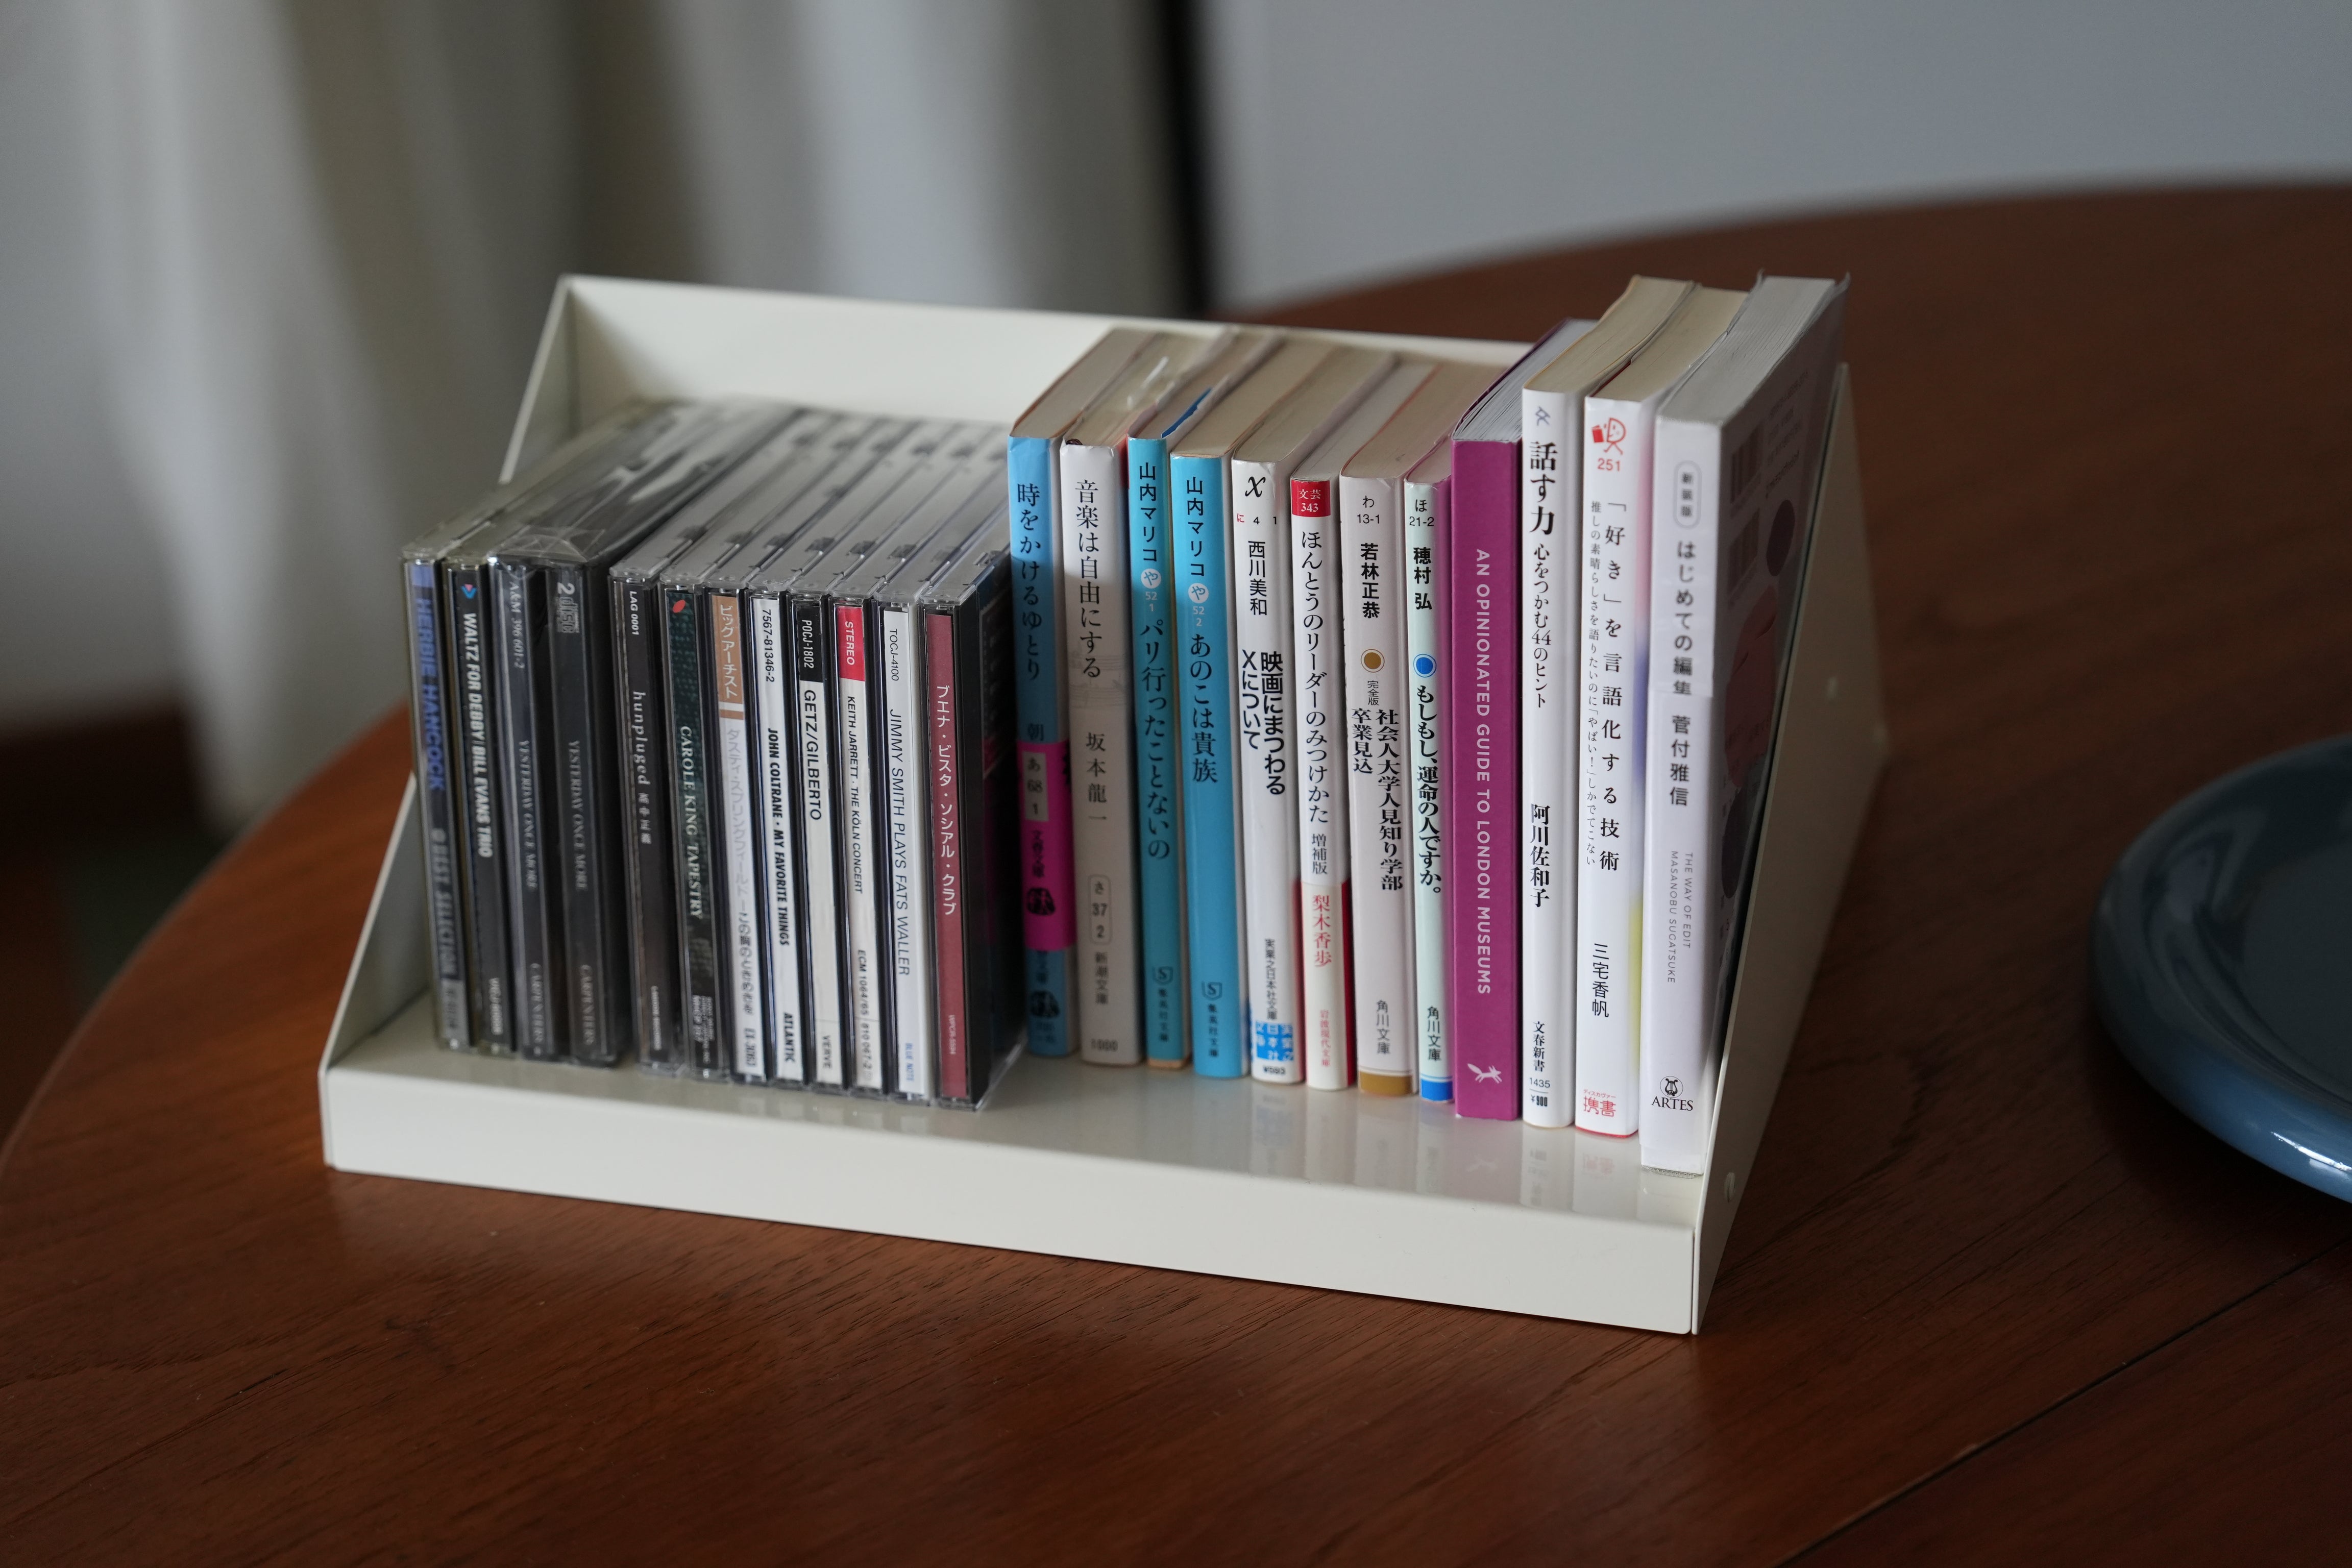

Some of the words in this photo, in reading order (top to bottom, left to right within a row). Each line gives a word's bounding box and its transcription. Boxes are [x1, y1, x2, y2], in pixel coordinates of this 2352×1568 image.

[1529, 441, 1558, 535] 話す力
[1597, 458, 1622, 472] 251
[1140, 462, 1158, 562] 山内マリコ
[1298, 489, 1321, 500] 文芸
[1301, 502, 1319, 512] 343
[1362, 496, 1374, 508] わ
[1415, 499, 1427, 511] ほ
[1187, 477, 1205, 577] 山内マリコ
[1237, 513, 1244, 523] に
[1357, 513, 1380, 525] 13-1
[1409, 517, 1435, 527] 21-2
[1017, 483, 1042, 680] 時をかけるゆとり
[1075, 479, 1102, 678] 音楽は自由にする
[1142, 570, 1160, 586] や
[1248, 541, 1267, 616] 西川美和
[1360, 543, 1379, 619] 若林正恭
[1476, 549, 1490, 576] AN
[557, 582, 575, 595] 2
[629, 591, 639, 612] LAG
[1145, 592, 1158, 601] 52
[1149, 603, 1154, 611] 1
[1191, 584, 1207, 601] や
[1193, 606, 1205, 615] 52
[416, 599, 437, 677] HERBIE
[463, 613, 480, 662] WALTZ
[512, 617, 523, 636] 396
[631, 615, 640, 635] 0001
[1196, 618, 1202, 627] 2
[1531, 544, 1552, 708] 心をつかむ44のヒント
[1673, 541, 1696, 696] はじめての編集
[513, 639, 526, 669] 601-2
[763, 608, 774, 682] 7567-81346-2
[801, 620, 814, 669] POCJ-1802
[845, 621, 855, 665] STEREO
[889, 628, 899, 681] TOCJ-4100
[1477, 584, 1490, 716] OPINIONATED
[467, 665, 481, 692] FOR
[1241, 649, 1261, 750] Xについて
[1301, 531, 1329, 823] ほんとうのリーダーのみつけかた
[1367, 680, 1379, 706] 完全版
[1600, 502, 1627, 871] 「好き」を言語化する技術
[468, 693, 485, 740] DEBBY
[847, 696, 856, 728] KEITH
[1190, 633, 1218, 783] あのこは貴族
[1261, 651, 1286, 795] 映画にまつわる
[423, 684, 446, 790] HANCOCK
[631, 691, 651, 786] hunpluged
[679, 726, 695, 789] CAROLE
[768, 728, 779, 758] JOHN
[803, 689, 822, 820] GETZ/GILBERTO
[848, 731, 859, 779] JARRETT
[890, 709, 903, 763] JIMMY
[1140, 619, 1171, 860] パリ行ったことないの
[1351, 708, 1374, 774] 卒業見込
[1477, 724, 1490, 782] GUIDE
[519, 740, 533, 810] YESTERDAY
[569, 740, 583, 811] YESTERDAY
[1086, 732, 1108, 820] 坂本龍一
[1670, 715, 1690, 806] 菅付雅信
[474, 777, 491, 824] EVANS
[769, 762, 783, 818] COLTRANE
[850, 787, 860, 806] THE
[892, 768, 905, 816] SMITH
[937, 685, 957, 915] ブエナ・ビスタ・ソシアル・クラブ
[1377, 708, 1403, 891] 社会人大学人見知り学部
[1417, 685, 1441, 894] もしもし、運命の人ですか。
[1477, 790, 1490, 813] TO
[523, 814, 535, 849] ONCE
[572, 814, 585, 850] ONCE
[683, 793, 697, 836] KING
[851, 808, 862, 839] KÖLN
[476, 826, 493, 857] TRIO
[774, 829, 784, 847] MY
[894, 823, 906, 868] PLAYS
[1311, 834, 1327, 874] 増補版
[1477, 821, 1490, 899] LONDON
[1530, 803, 1551, 908] 阿川佐和子
[432, 845, 451, 884] BEST
[525, 853, 537, 889] MORE
[575, 854, 588, 891] MORE
[687, 843, 703, 918] TAPESTRY
[775, 851, 788, 903] FAVORITE
[853, 841, 863, 894] CONCERT
[1669, 851, 1679, 915] MASANOBU
[1685, 852, 1693, 873] THE
[895, 875, 908, 910] FATS
[1092, 903, 1107, 917] 37
[1684, 877, 1693, 903] WAY
[1684, 904, 1692, 920] OF
[778, 906, 790, 946] THINGS
[897, 916, 910, 975] WALLER
[1096, 925, 1105, 938] 2
[1312, 895, 1332, 967] 梨木香歩
[1683, 923, 1691, 948] EDIT
[857, 949, 866, 972] ECM
[1477, 907, 1491, 994] MUSEUMS
[1667, 918, 1677, 983] SUGATSUKE
[859, 976, 869, 1016] 1064/65
[1591, 943, 1609, 1018] 三宅香帆
[784, 1013, 795, 1063] ATLANTIC
[1376, 1000, 1390, 1055] 角川文庫
[1428, 1005, 1442, 1062] 角川文庫
[1533, 1021, 1545, 1072] 文春新書
[822, 1035, 832, 1068] VERVE
[905, 1042, 914, 1060] BLUE
[1529, 1077, 1551, 1088] 1435
[1531, 1094, 1548, 1107] ¥900
[1583, 1089, 1616, 1098] ディスカヴァー
[1651, 1096, 1694, 1112] ARTES
[1583, 1095, 1616, 1117] 携書
